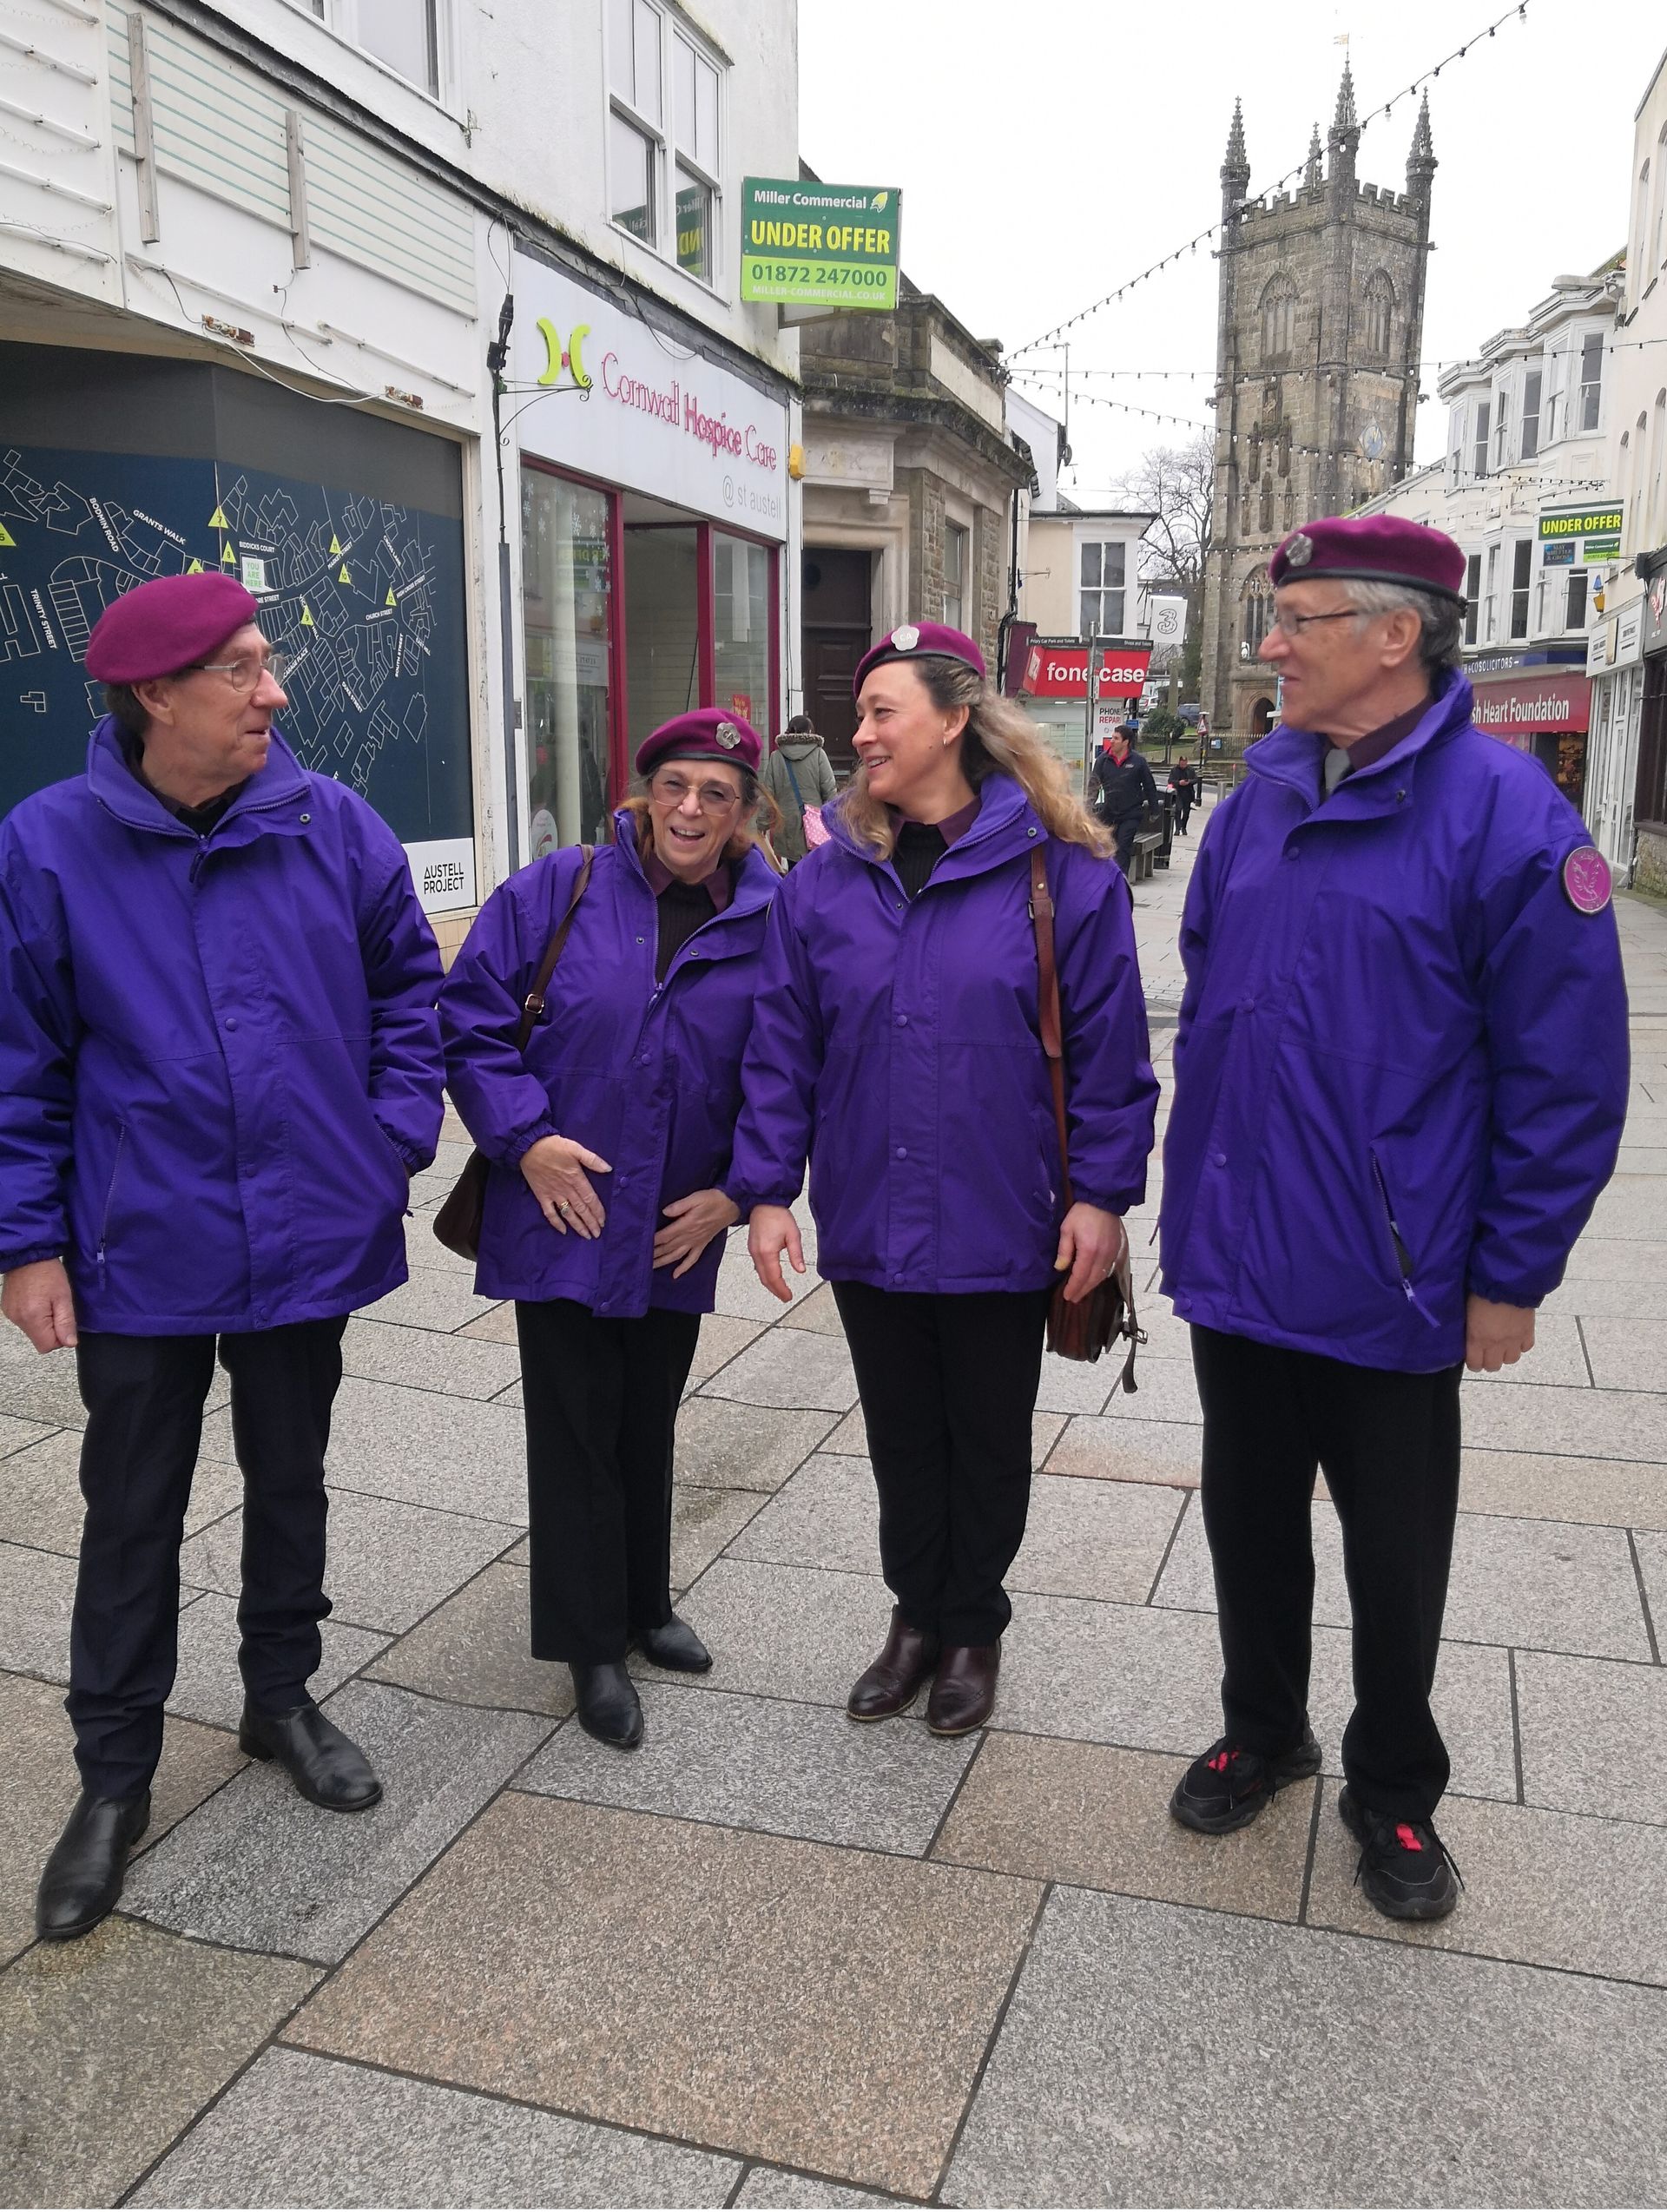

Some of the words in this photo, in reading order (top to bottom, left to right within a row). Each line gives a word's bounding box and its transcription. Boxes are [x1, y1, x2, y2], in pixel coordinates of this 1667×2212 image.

[754, 190, 791, 204] Miller
[793, 193, 866, 209] Commercial
[751, 220, 822, 249] UNDER
[827, 226, 890, 253] OFFER
[752, 264, 810, 283] 01872
[815, 267, 887, 286] 247000
[752, 286, 886, 300] MILLER-COMMERCIAL.CO.UK
[602, 352, 680, 426] Cornwall
[683, 392, 742, 458] Hospice
[745, 425, 777, 471] Care
[722, 475, 735, 508] @
[737, 486, 747, 507] st
[750, 490, 781, 521] austell
[89, 497, 109, 530] BODMIN
[103, 527, 120, 552] ROAD
[133, 509, 163, 531] GRANTS
[163, 528, 187, 545] WALK
[1542, 518, 1583, 535] UNDER
[1584, 515, 1622, 530] OFFER
[260, 544, 275, 553] COURT
[247, 562, 260, 570] YOU
[264, 594, 280, 603] STREET
[30, 588, 49, 621] TRINITY
[41, 619, 57, 649] STREET
[1157, 608, 1178, 635] 3
[1479, 656, 1513, 673] SOLICITORS
[1098, 668, 1145, 683] case
[1483, 699, 1509, 723] Heart
[1510, 693, 1570, 722] Foundation
[424, 862, 465, 879] AUSTELL
[424, 877, 465, 895] PROJECT
